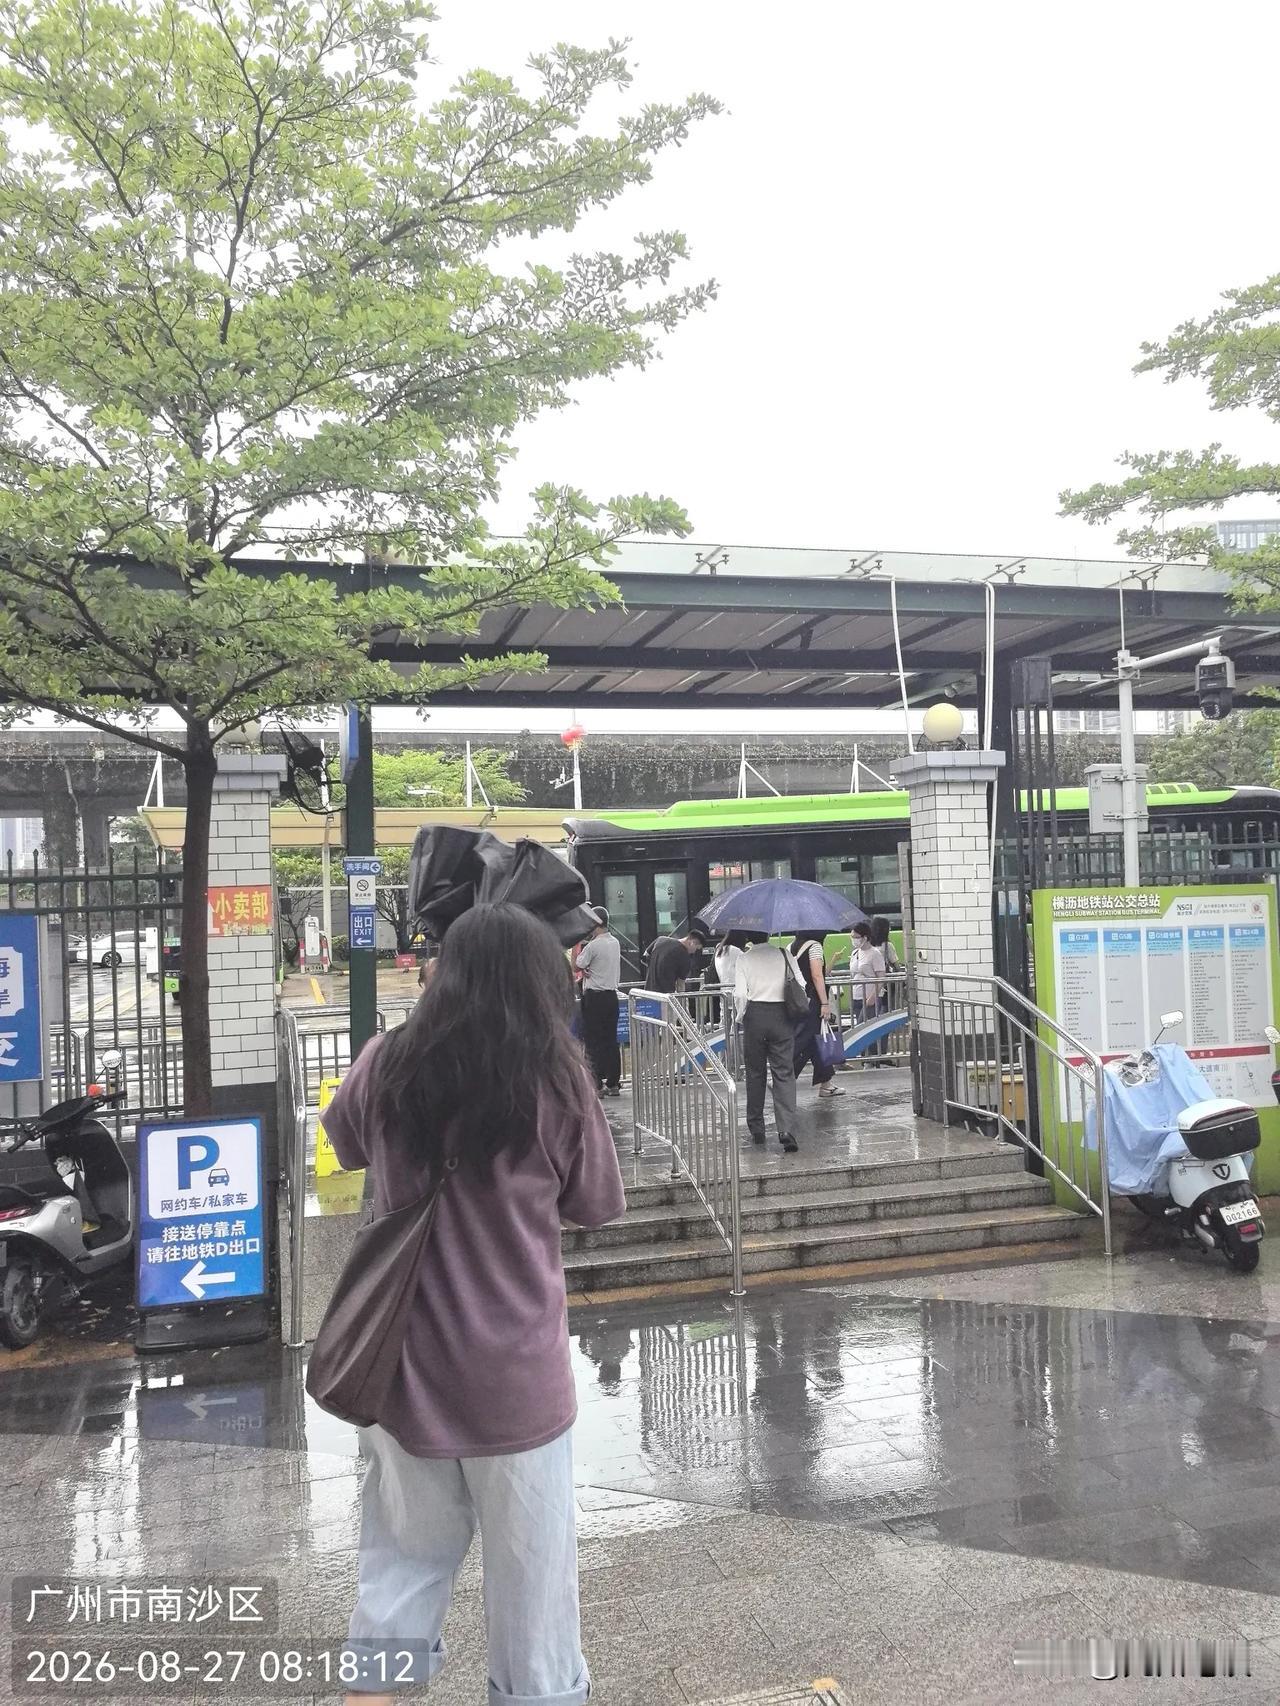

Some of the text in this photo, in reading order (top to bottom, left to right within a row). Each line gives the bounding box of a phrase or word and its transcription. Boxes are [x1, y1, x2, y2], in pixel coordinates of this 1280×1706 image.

[346, 862, 370, 871] 洗手间
[215, 890, 269, 920] 小卖部
[1052, 893, 1161, 910] 横沥地铁站公交总站
[354, 915, 373, 928] 出口
[1053, 910, 1074, 918] HENGLI
[354, 928, 373, 936] EXIT
[177, 1135, 220, 1190] P
[160, 1193, 248, 1213] 网约车/私家车
[162, 1220, 246, 1243] 接送停靠点
[147, 1238, 260, 1263] 请往地铁D出口
